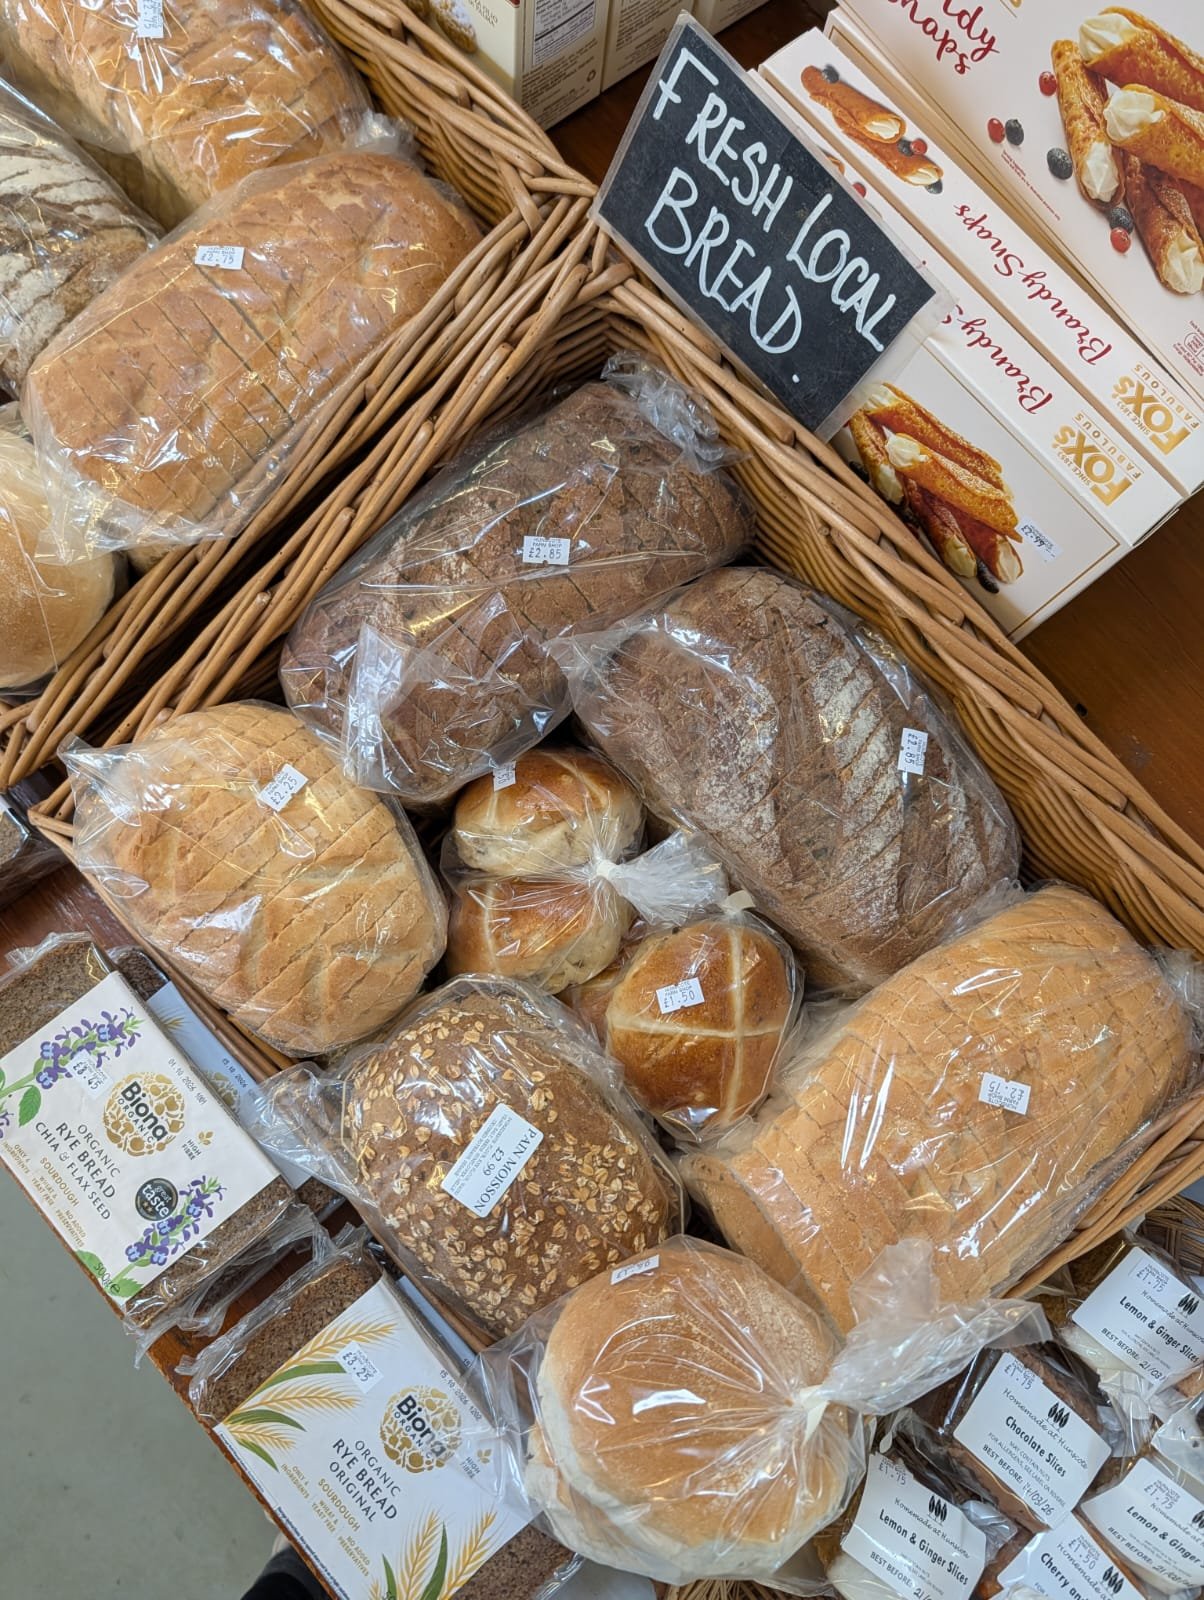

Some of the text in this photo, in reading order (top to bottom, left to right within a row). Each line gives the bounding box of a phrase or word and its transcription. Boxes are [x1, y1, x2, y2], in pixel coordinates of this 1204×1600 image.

[653, 48, 885, 353] FRESH LOCAL
[201, 253, 234, 264] £2.75
[953, 204, 1025, 277] Snaps
[1017, 271, 1112, 365] Brandy
[956, 317, 1053, 415] Brandy
[1134, 363, 1200, 430] FABULOUS
[1075, 412, 1142, 480] FABULOUS
[528, 548, 562, 560] £2.85
[904, 733, 918, 764] £2.85
[270, 776, 298, 804] £2.25
[664, 990, 695, 1008] £1.50
[989, 1081, 1024, 1100] £2.75
[118, 1098, 154, 1143] ORGANIC
[121, 1080, 168, 1142] Biona
[56, 1122, 116, 1198] RYE BREAD
[78, 1124, 120, 1178] ORGANIC
[187, 1139, 202, 1156] HIGH
[483, 1147, 505, 1176] £2.99
[513, 1128, 537, 1157] PAIN
[36, 1122, 111, 1220] CHIA & FLAX SEED
[40, 1156, 80, 1207] SOURDOUGH
[474, 1156, 517, 1212] MOISSON
[142, 1184, 170, 1218] taste
[154, 1186, 172, 1202] great
[1136, 1270, 1168, 1292] £1.75
[1101, 1328, 1118, 1342] BEST
[1120, 1296, 1147, 1324] Lemon
[1148, 1320, 1157, 1330] &
[1156, 1325, 1181, 1350] Ginger
[1180, 1344, 1200, 1364] Slices
[342, 1352, 372, 1382] £3.25
[1004, 1362, 1033, 1390] £1.75
[396, 1394, 447, 1458] Biona
[1003, 1388, 1048, 1431] Homemade
[1047, 1429, 1059, 1440] at
[982, 1444, 1000, 1460] BEST
[998, 1458, 1024, 1484] BEFORE:
[1006, 1416, 1067, 1478] Chocolate Slices
[281, 1464, 310, 1499] INGREDIENTS
[332, 1438, 398, 1520] RYE BREAD
[355, 1440, 401, 1497] ORGANIC
[879, 1462, 906, 1486] £1.75
[318, 1478, 360, 1532] SOURDOUGH
[329, 1461, 378, 1522] ORIGINAL
[1144, 1484, 1174, 1510] £1.75
[312, 1503, 326, 1522] YEAST
[894, 1497, 933, 1530] Homemade
[346, 1536, 371, 1566] NO ADDED
[880, 1508, 908, 1538] Lemon
[909, 1532, 917, 1545] &
[918, 1540, 947, 1568] Ginger
[946, 1562, 969, 1586] Slices
[1108, 1526, 1126, 1542] BEST
[1126, 1506, 1159, 1534] Lemon
[1158, 1532, 1169, 1540] &
[1168, 1538, 1201, 1566] Ginger
[338, 1536, 370, 1577] PRESERVATIVES
[870, 1552, 887, 1566] BEST
[1040, 1552, 1070, 1588] Cherry
[1068, 1538, 1096, 1570] £1.50
